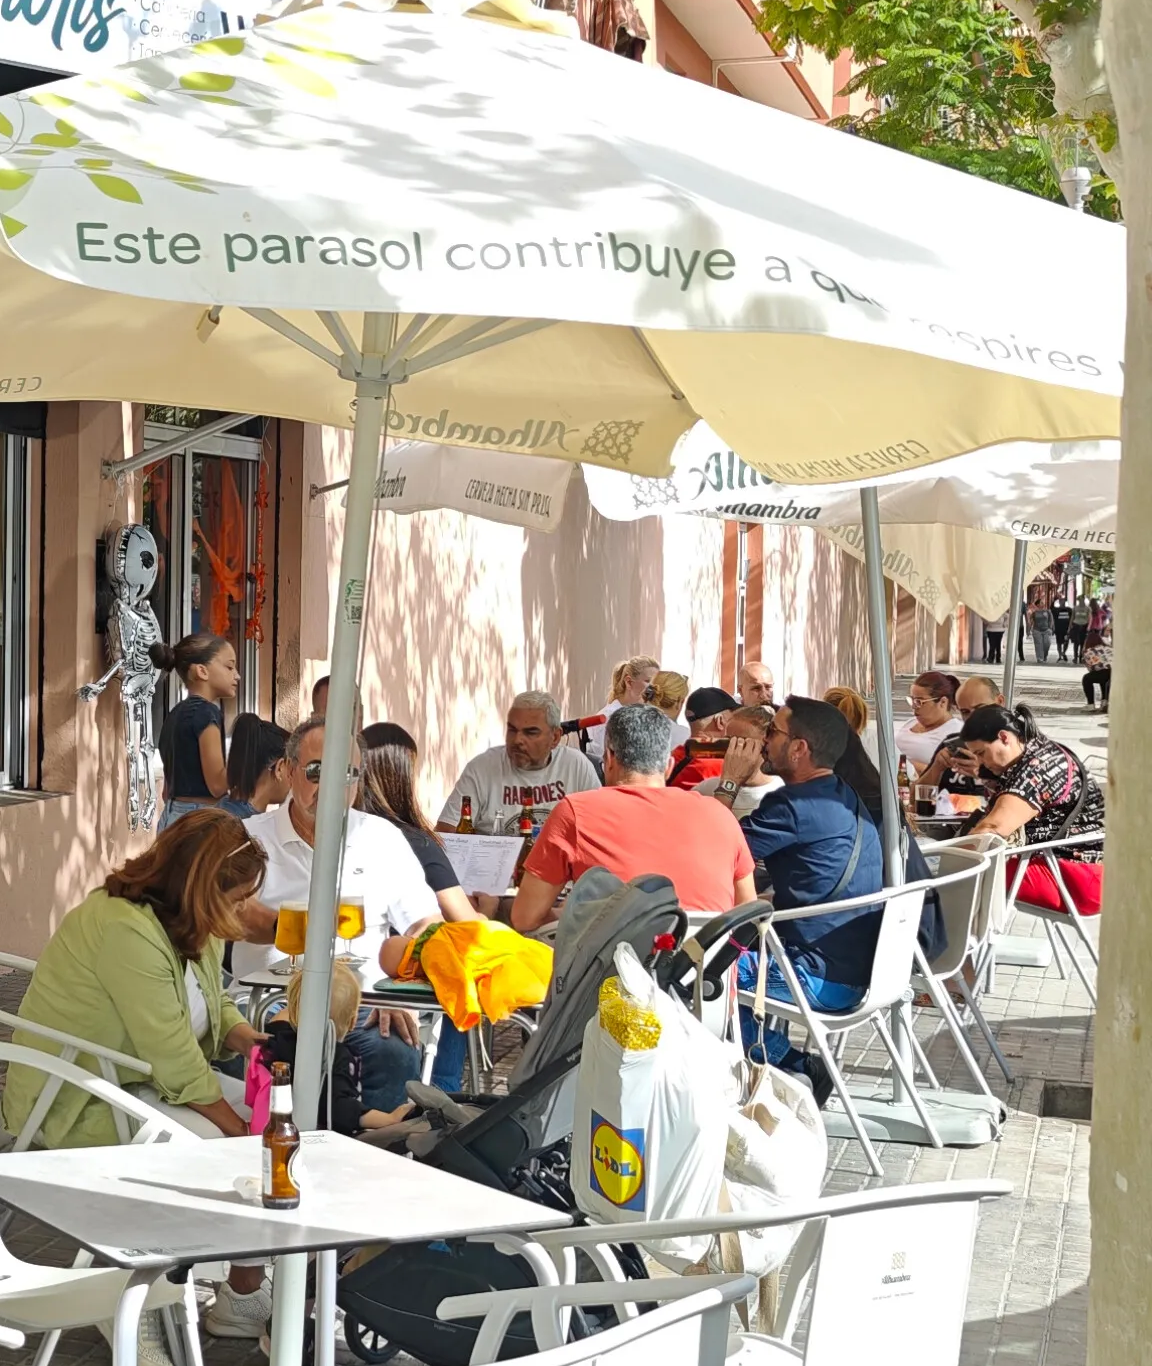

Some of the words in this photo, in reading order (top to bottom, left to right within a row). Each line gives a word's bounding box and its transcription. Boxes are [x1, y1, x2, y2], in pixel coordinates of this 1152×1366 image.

[75, 221, 201, 265] Este
[223, 231, 424, 272] parasol
[445, 230, 737, 292] contribuye
[764, 254, 793, 284] a
[810, 268, 890, 313] qu
[1011, 519, 1079, 542] CERVEZA
[1083, 530, 1116, 544] HEC
